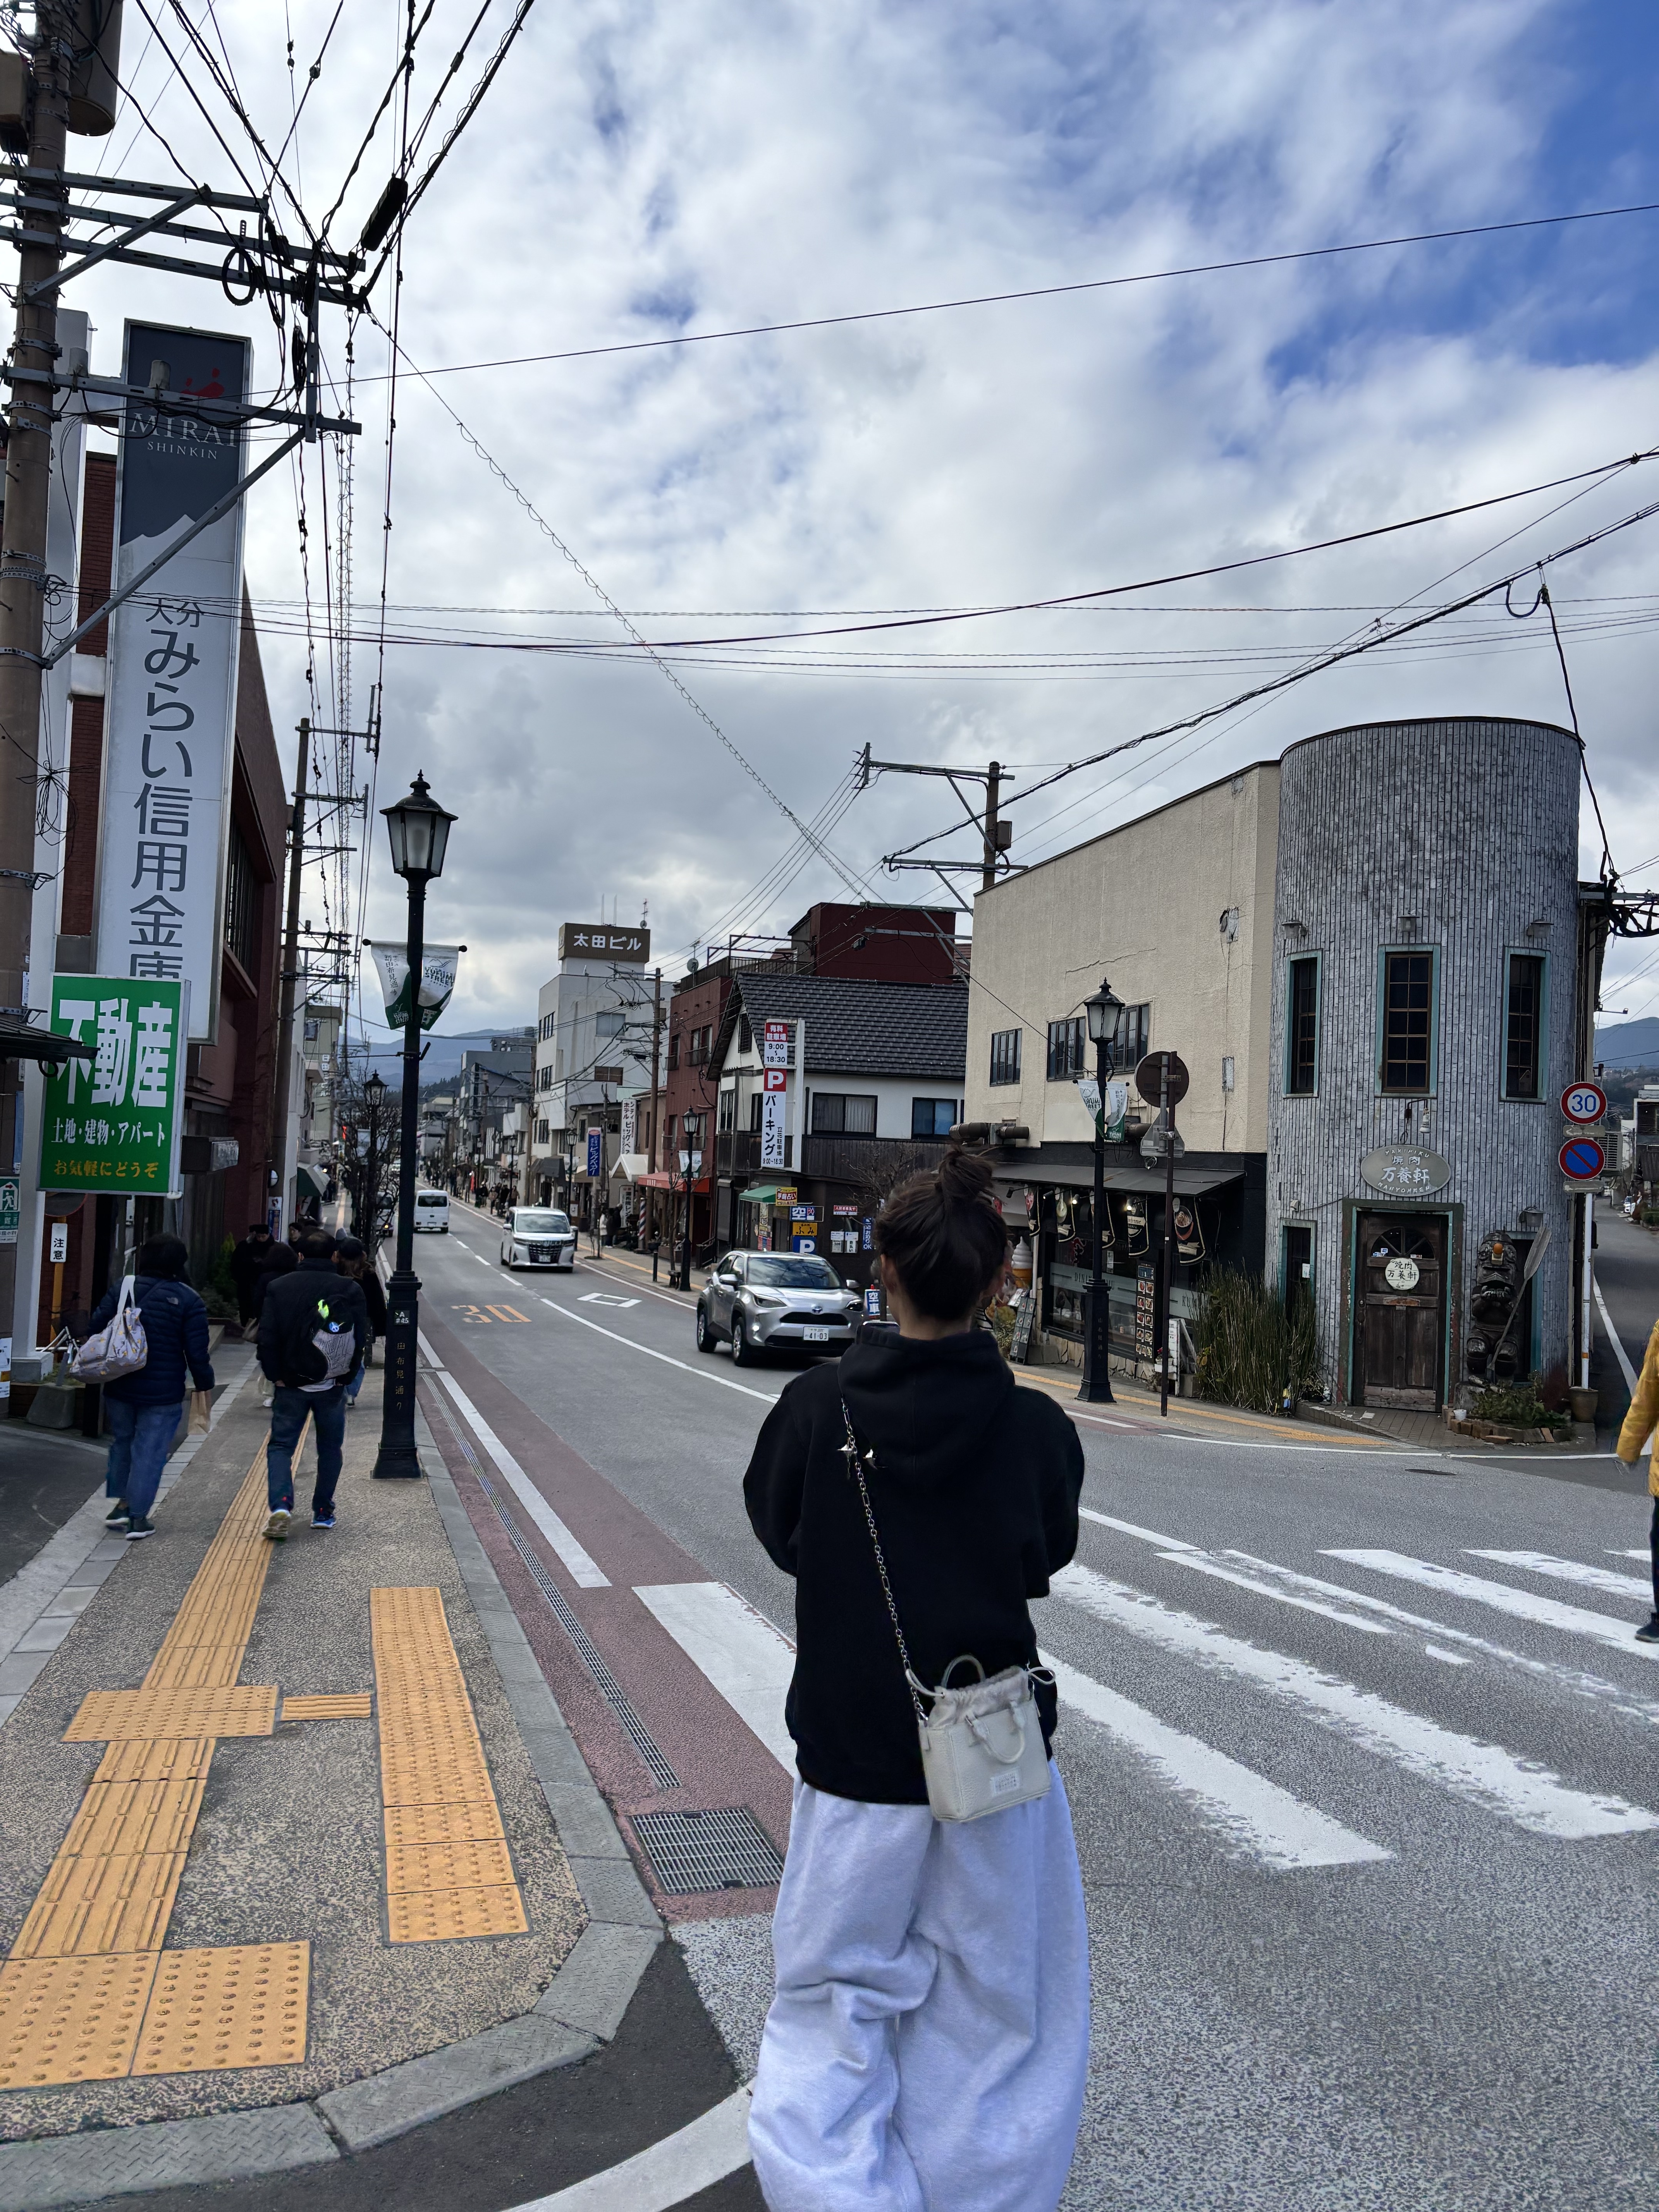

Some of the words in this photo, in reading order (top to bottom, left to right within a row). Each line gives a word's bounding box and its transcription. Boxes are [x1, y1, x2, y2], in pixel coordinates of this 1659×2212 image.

[130, 413, 237, 448] MIRAI
[147, 441, 218, 460] SHINKIN
[573, 933, 641, 951] 太田ビル
[57, 998, 172, 1107] 不動産
[767, 1071, 784, 1089] P
[1571, 1094, 1596, 1112] 30
[51, 1118, 166, 1147] 土地・建物・アパート
[764, 1095, 776, 1156] パーキング
[1385, 1148, 1430, 1158] YAKINIKU
[1392, 1156, 1420, 1165] 焼肉
[54, 1160, 159, 1178] お気軽にどうぞ
[1381, 1166, 1430, 1185] 万養軒
[792, 1207, 806, 1220] 空
[53, 1238, 64, 1260] 注意
[799, 1240, 815, 1253] P
[1394, 1261, 1412, 1270] 焼肉
[1387, 1270, 1417, 1281] 万養軒
[868, 1292, 880, 1313] 空車
[451, 1305, 532, 1322] 30
[395, 1343, 405, 1410] 由布見通り
